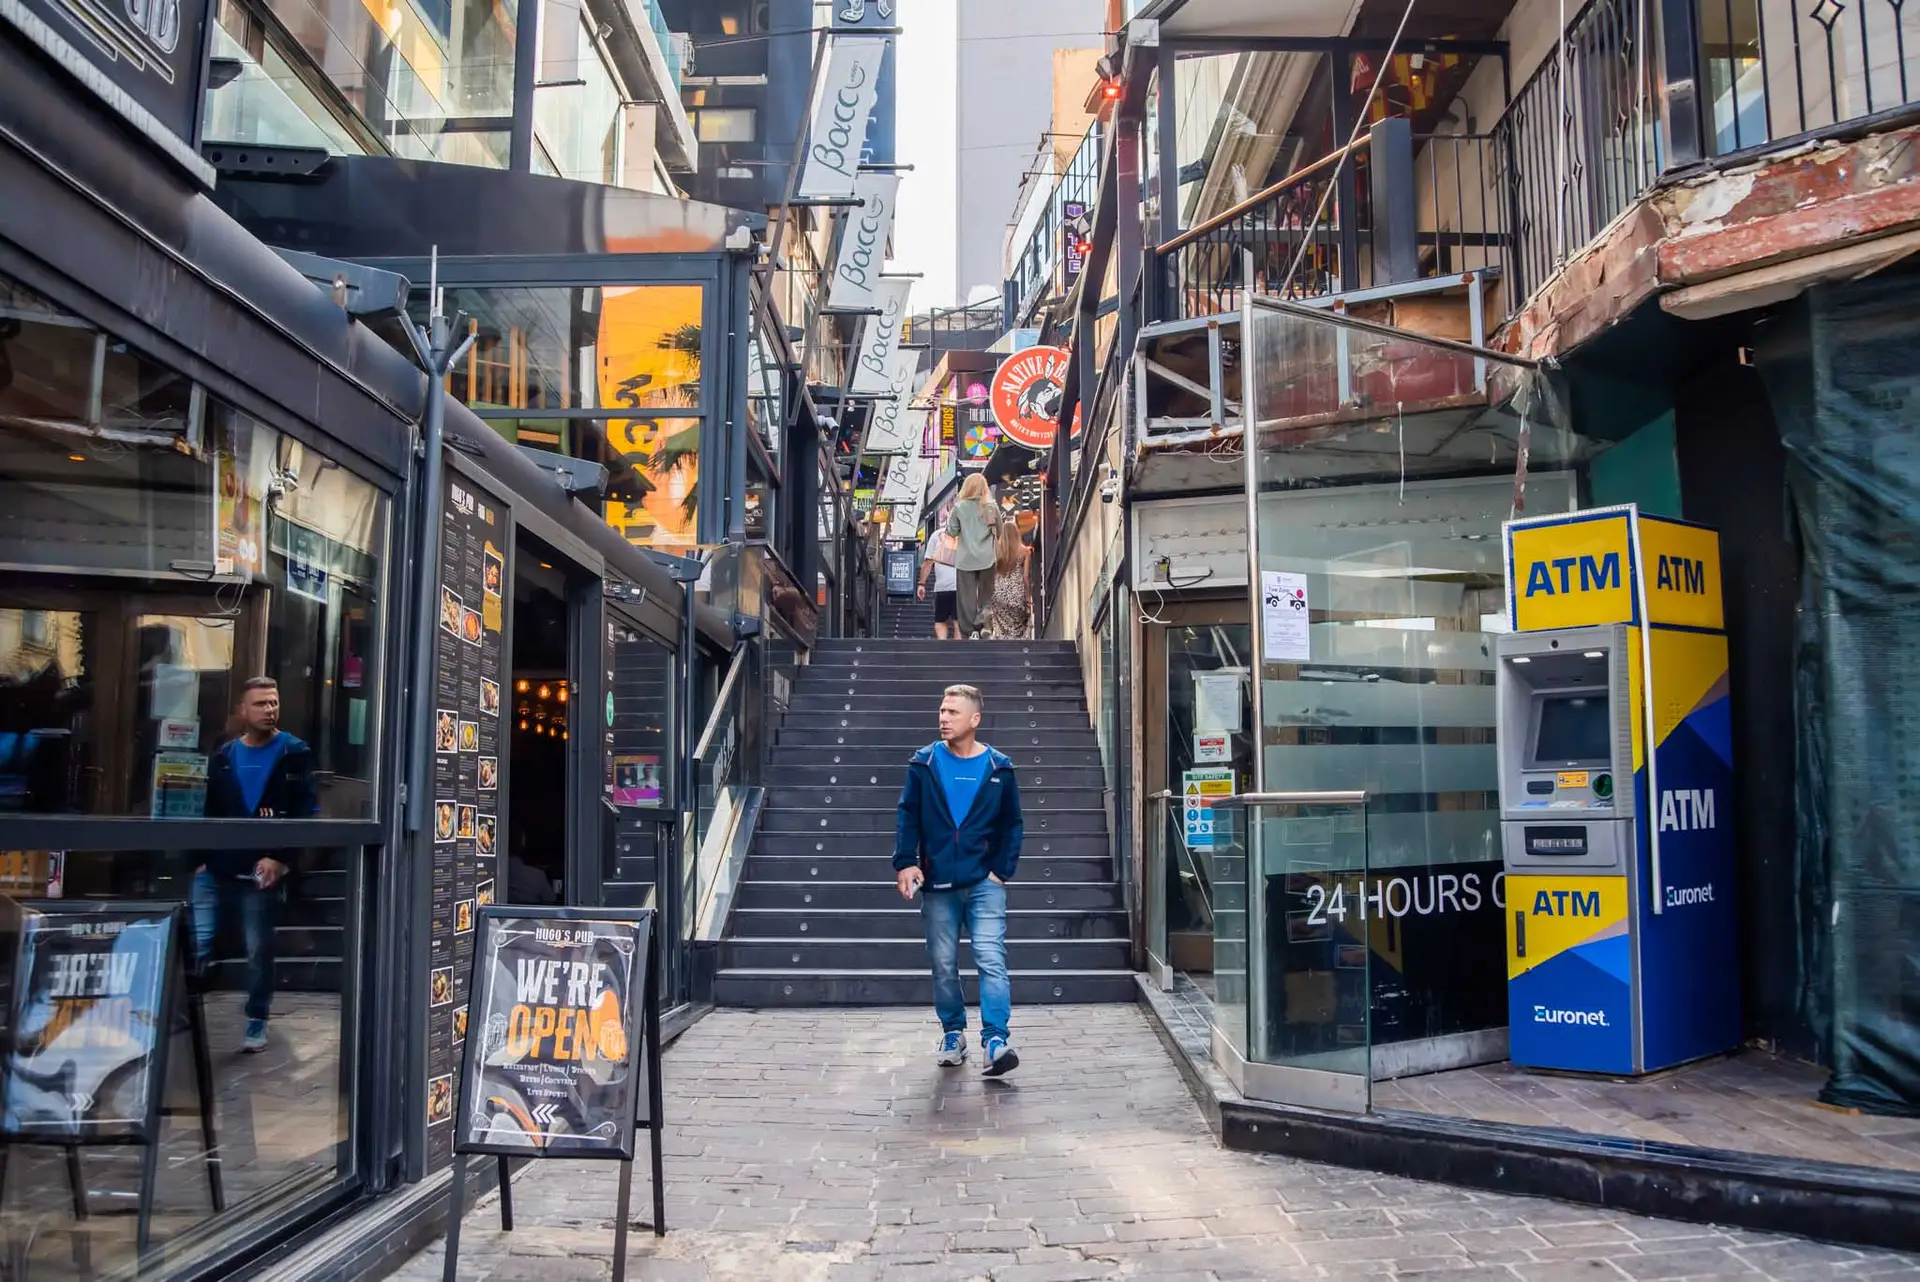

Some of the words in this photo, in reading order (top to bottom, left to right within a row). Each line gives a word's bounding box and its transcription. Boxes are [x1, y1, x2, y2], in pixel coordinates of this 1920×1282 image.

[1001, 355, 1044, 395] NATIVE
[942, 406, 955, 440] SOCIAL
[1525, 552, 1621, 598] ATM
[1657, 554, 1705, 595] ATM
[1659, 788, 1715, 833] ATM
[1306, 882, 1347, 926] 24
[1358, 872, 1482, 921] HOURS
[1532, 890, 1600, 917] ATM
[1666, 882, 1714, 907] Euronet
[535, 927, 571, 941] HUGO'S
[574, 931, 594, 943] PUB
[516, 958, 606, 1009] WE'RE
[507, 1003, 600, 1061] OPEN
[1533, 1004, 1607, 1027] Euronet
